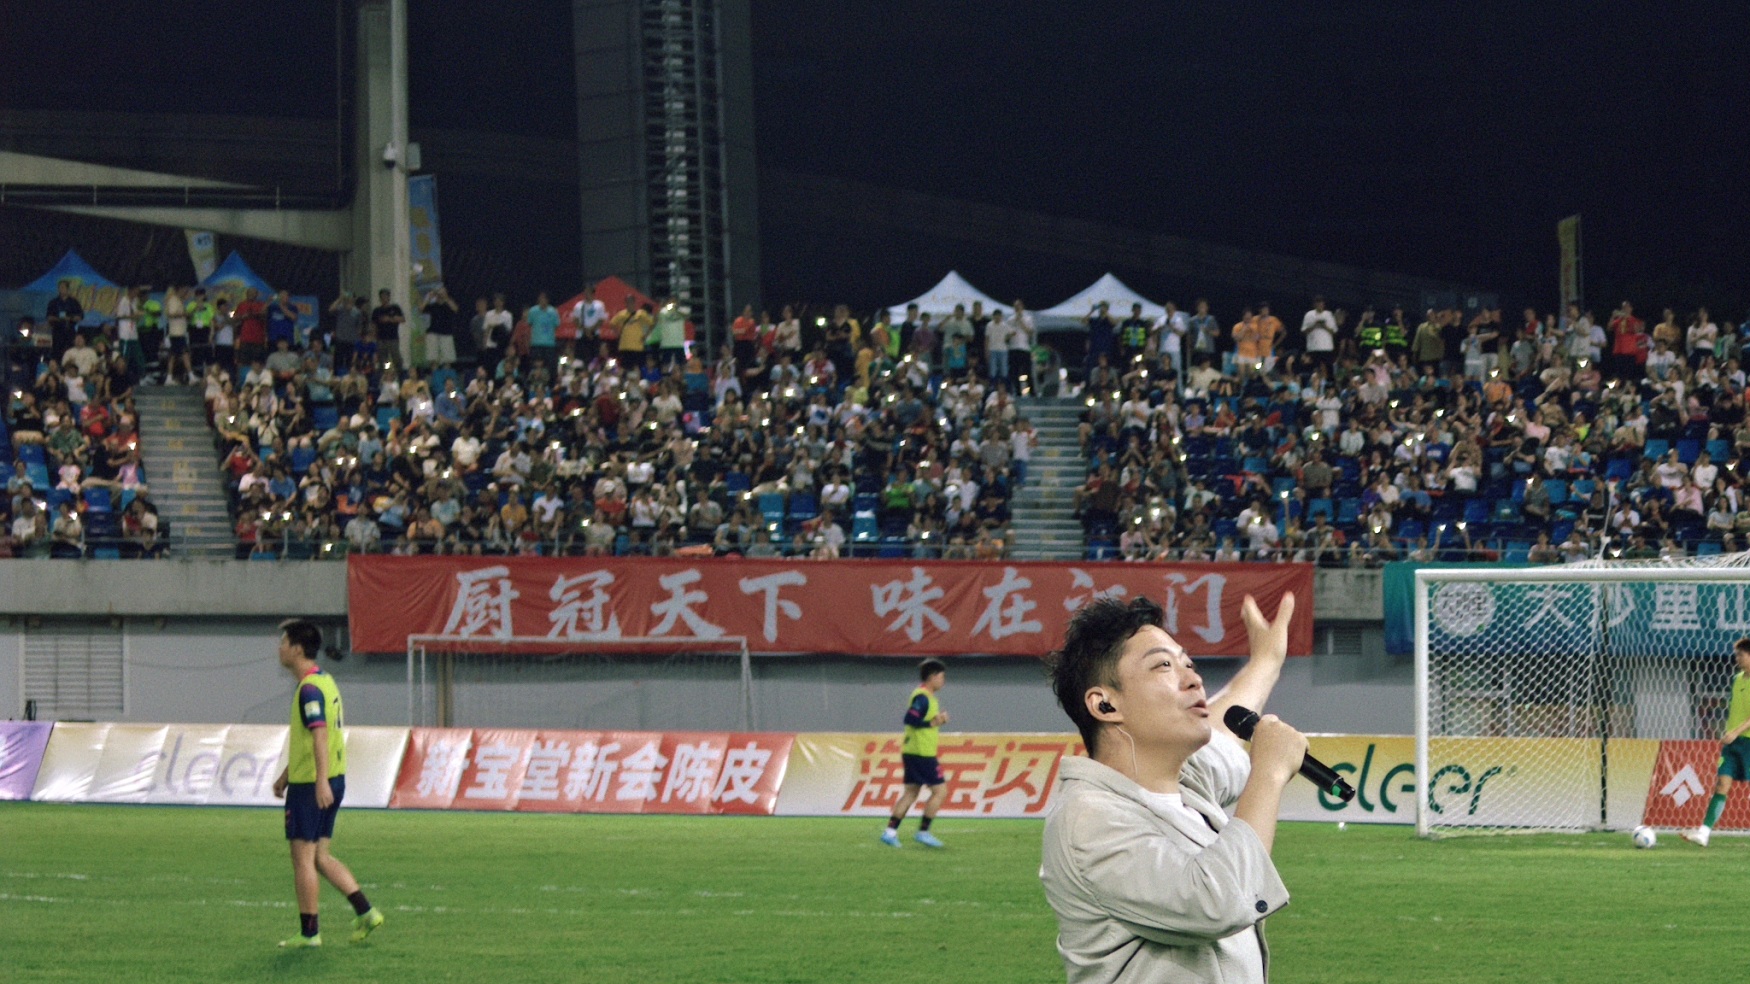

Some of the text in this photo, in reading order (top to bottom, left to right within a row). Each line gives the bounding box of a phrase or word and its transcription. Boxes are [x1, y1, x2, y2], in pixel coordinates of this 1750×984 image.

[443, 565, 807, 643] 厨冠天下
[415, 740, 773, 804] 新宝堂新会陈皮
[841, 739, 1089, 813] 淘宝闪
[1317, 743, 1504, 816] cleer
